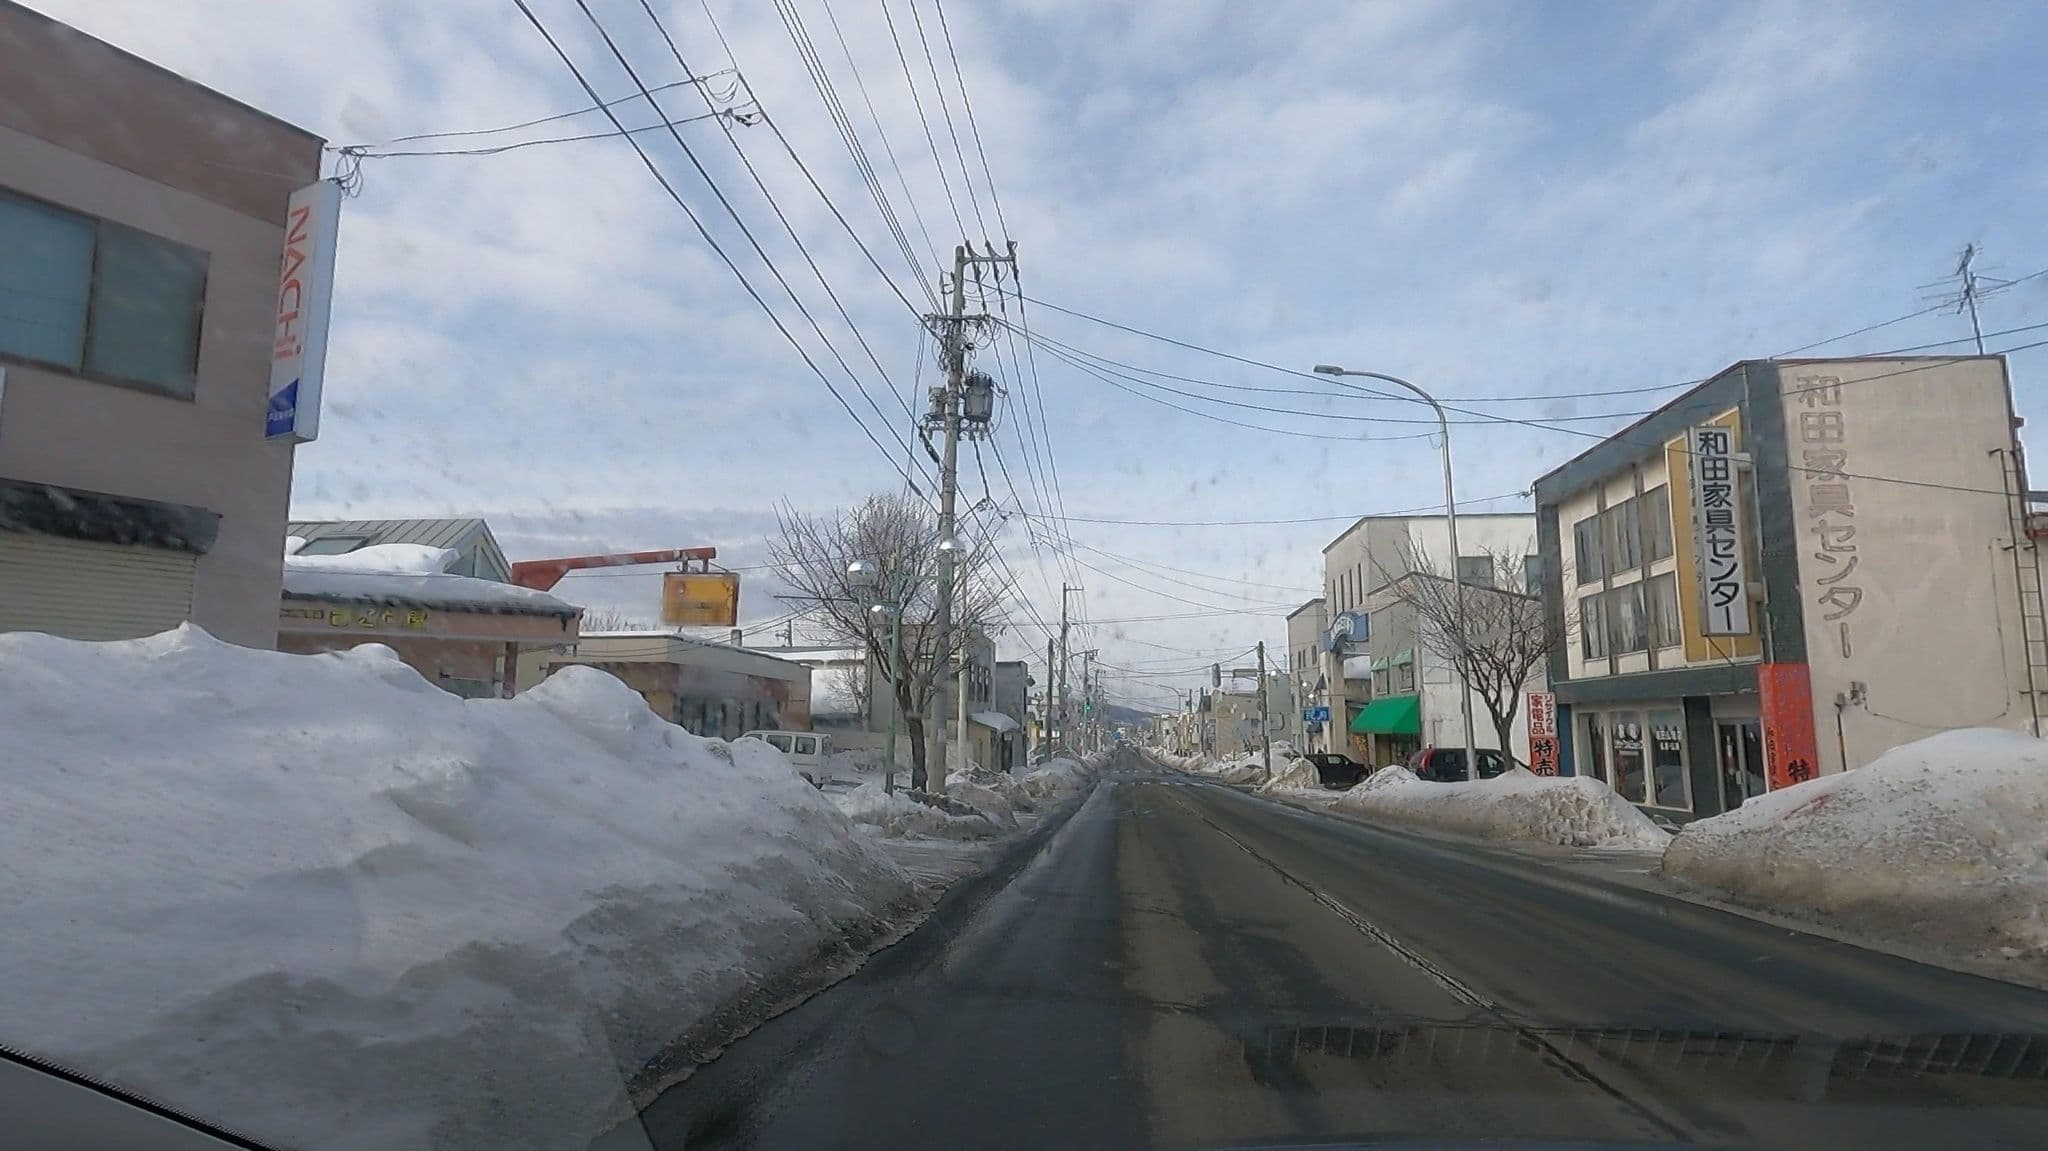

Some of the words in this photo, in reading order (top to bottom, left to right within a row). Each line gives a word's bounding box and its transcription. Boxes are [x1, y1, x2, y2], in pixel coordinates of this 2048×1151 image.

[1698, 430, 1740, 632] 和田家具センター
[1796, 374, 1863, 659] 和田家具センター
[1531, 694, 1545, 735] 家電品
[1534, 739, 1555, 777] 特売
